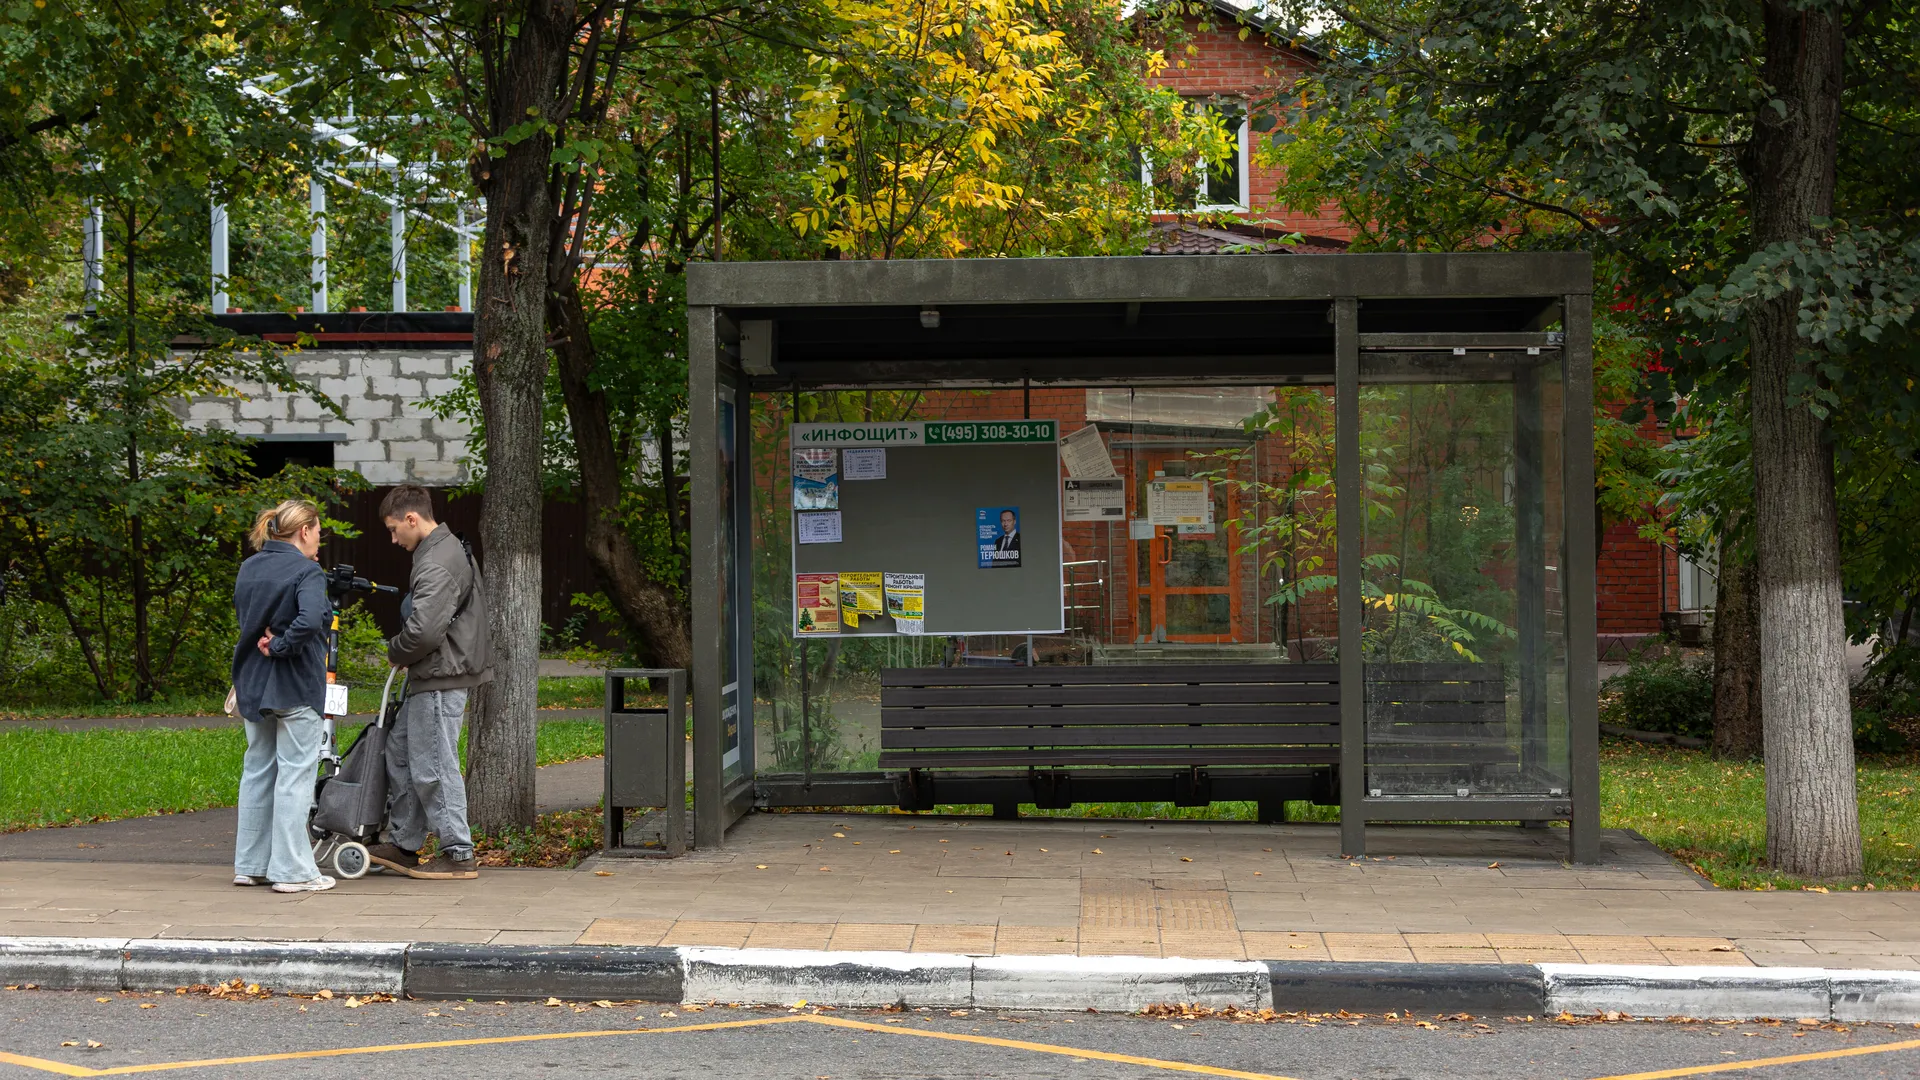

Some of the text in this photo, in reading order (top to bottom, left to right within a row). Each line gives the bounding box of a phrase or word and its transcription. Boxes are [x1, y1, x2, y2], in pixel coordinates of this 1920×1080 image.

[801, 427, 918, 442] «ИНФОЩИТ»
[941, 424, 1050, 440] (495) 308-30-10
[980, 550, 1020, 560] ТЕРЮШКОВ
